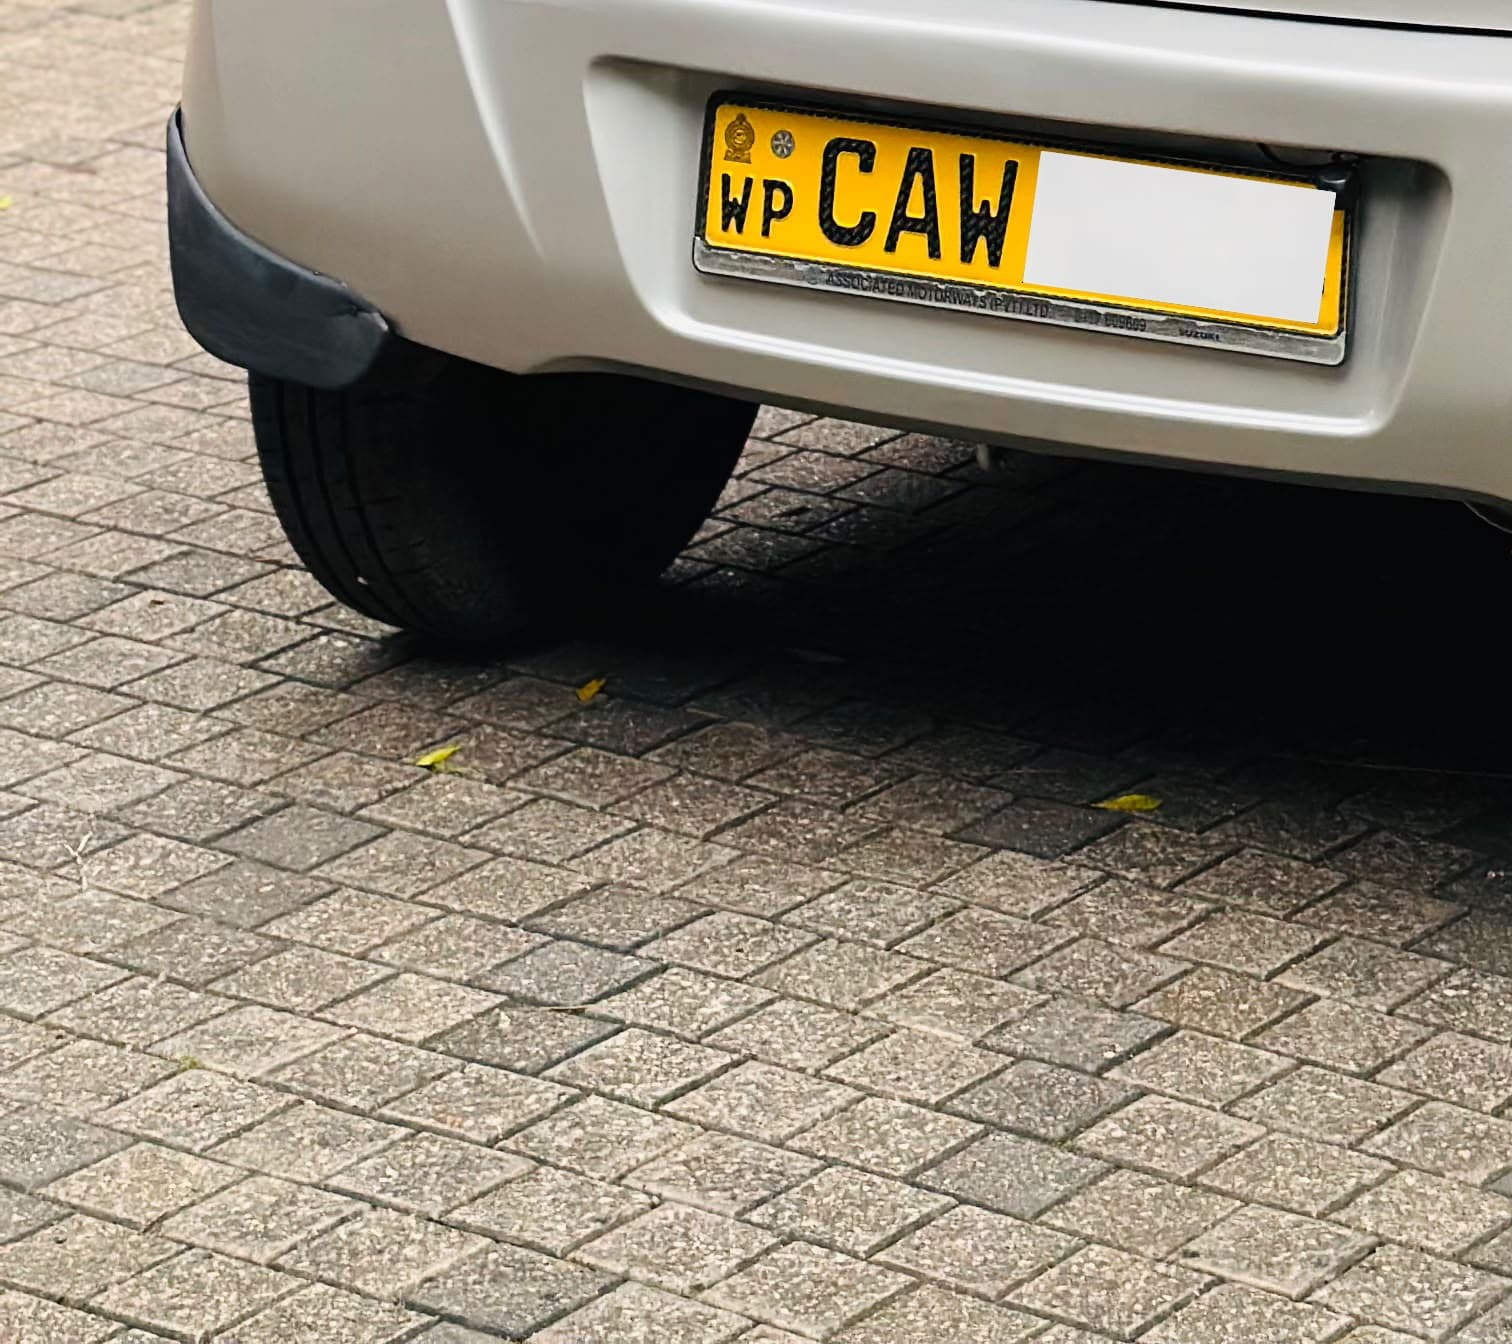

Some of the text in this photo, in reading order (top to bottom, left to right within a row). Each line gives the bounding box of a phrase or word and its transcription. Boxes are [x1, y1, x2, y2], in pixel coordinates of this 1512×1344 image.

[720, 136, 1020, 268] WP CAW
[825, 268, 905, 297] ASSOCIATED
[907, 279, 987, 309] MOTORWAYS
